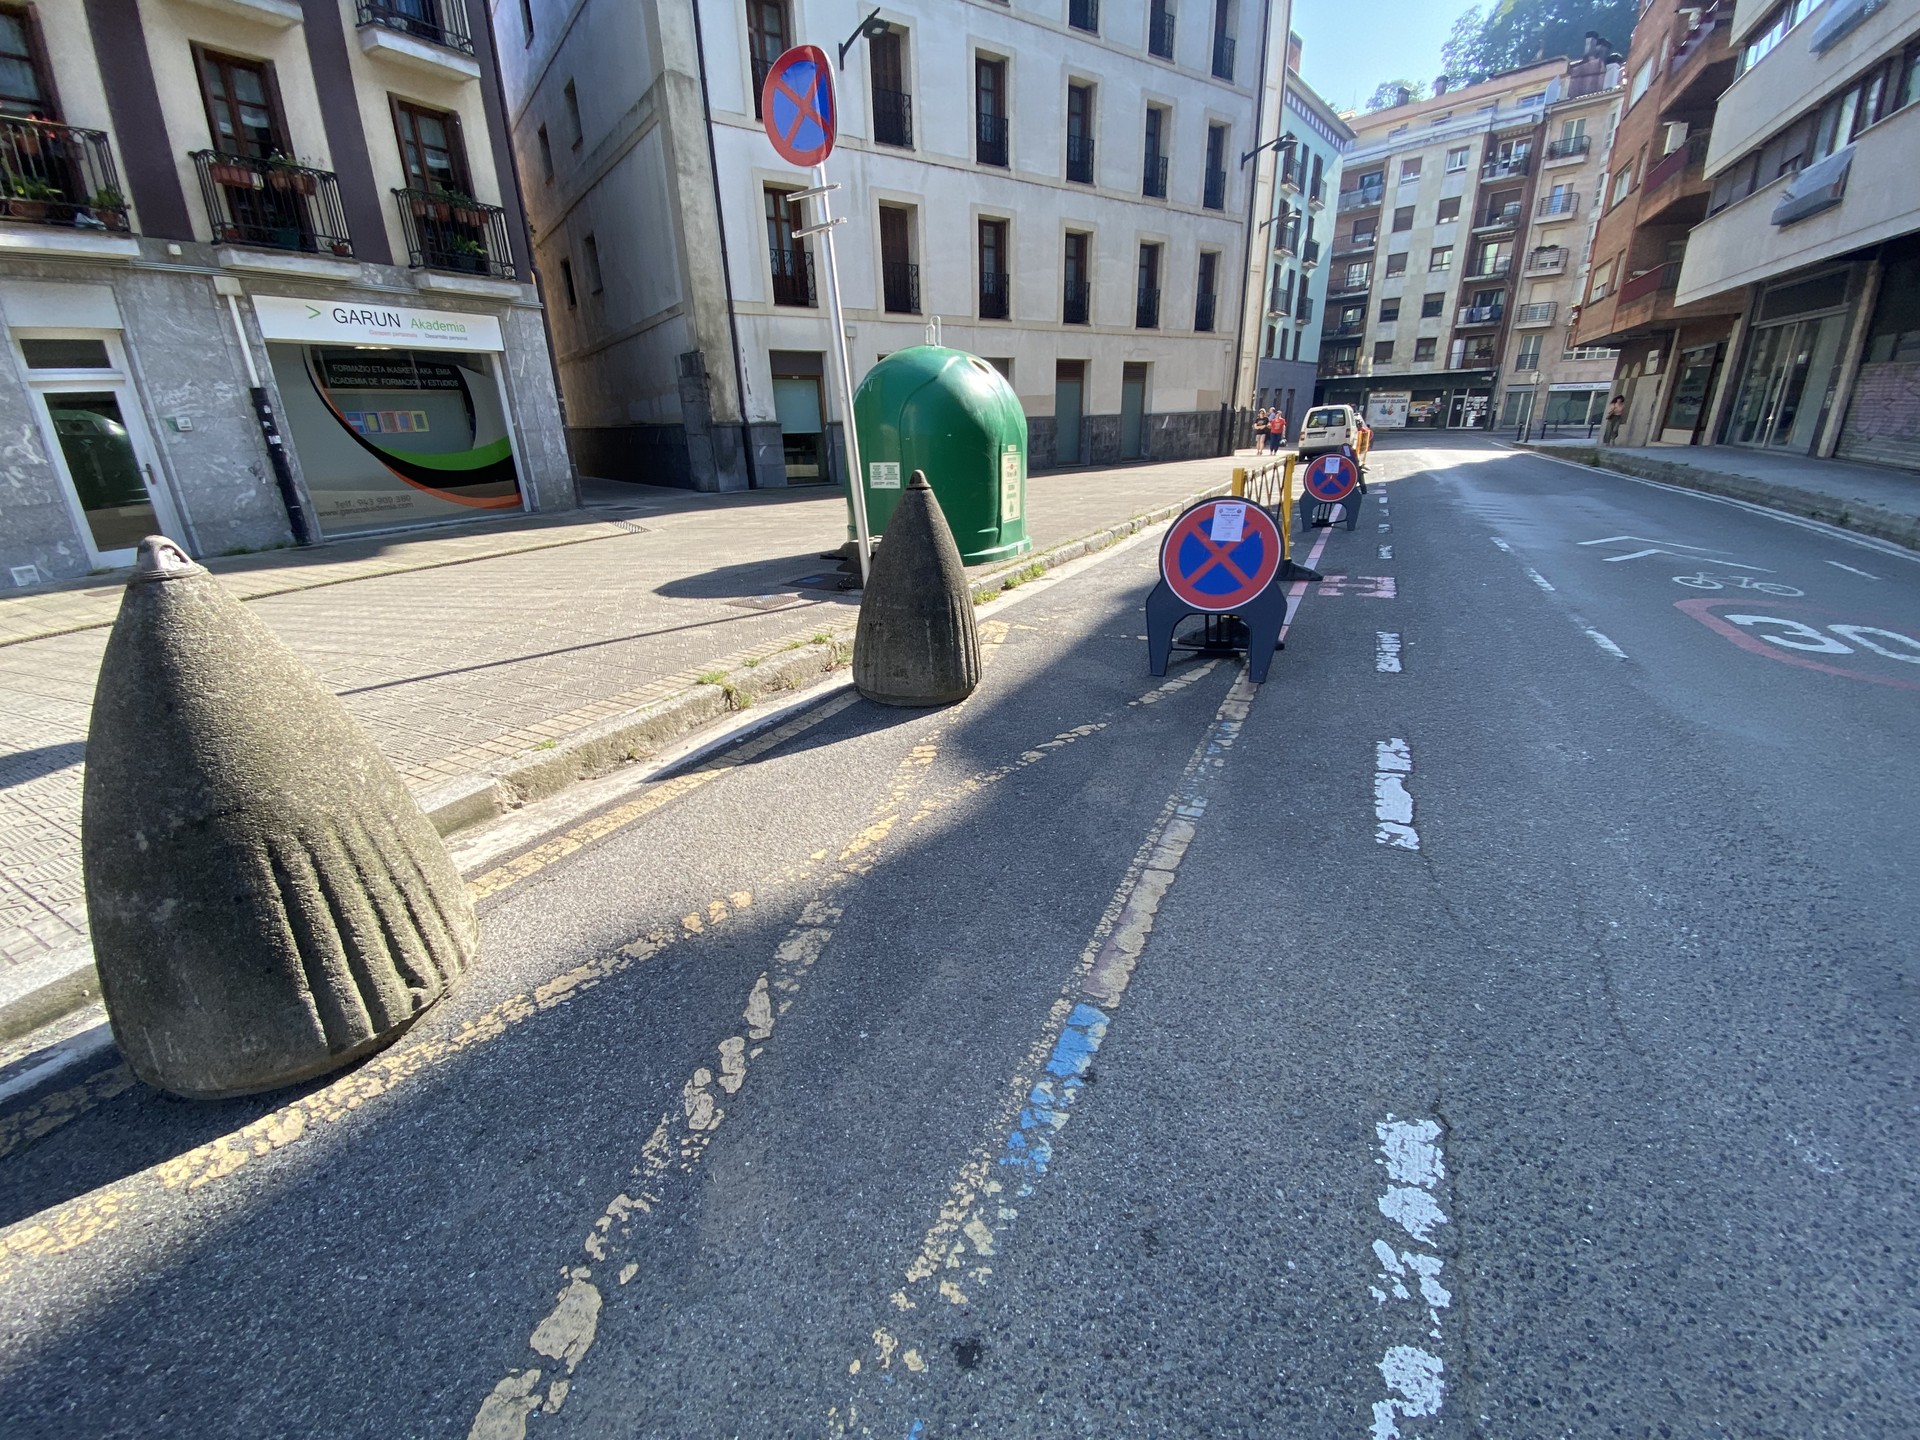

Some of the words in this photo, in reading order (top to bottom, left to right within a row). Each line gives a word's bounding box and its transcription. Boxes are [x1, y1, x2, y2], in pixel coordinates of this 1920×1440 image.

[332, 307, 401, 328] GARUN
[411, 318, 466, 333] Akademia
[332, 364, 371, 373] FORMAZIO
[386, 366, 419, 375] IKASKETA
[330, 377, 368, 385] ACADEMIA
[368, 378, 378, 386] DE
[428, 379, 459, 387] ESTUDIOS
[357, 498, 375, 506] 943
[377, 496, 393, 504] 900
[1724, 614, 1920, 665] 30
